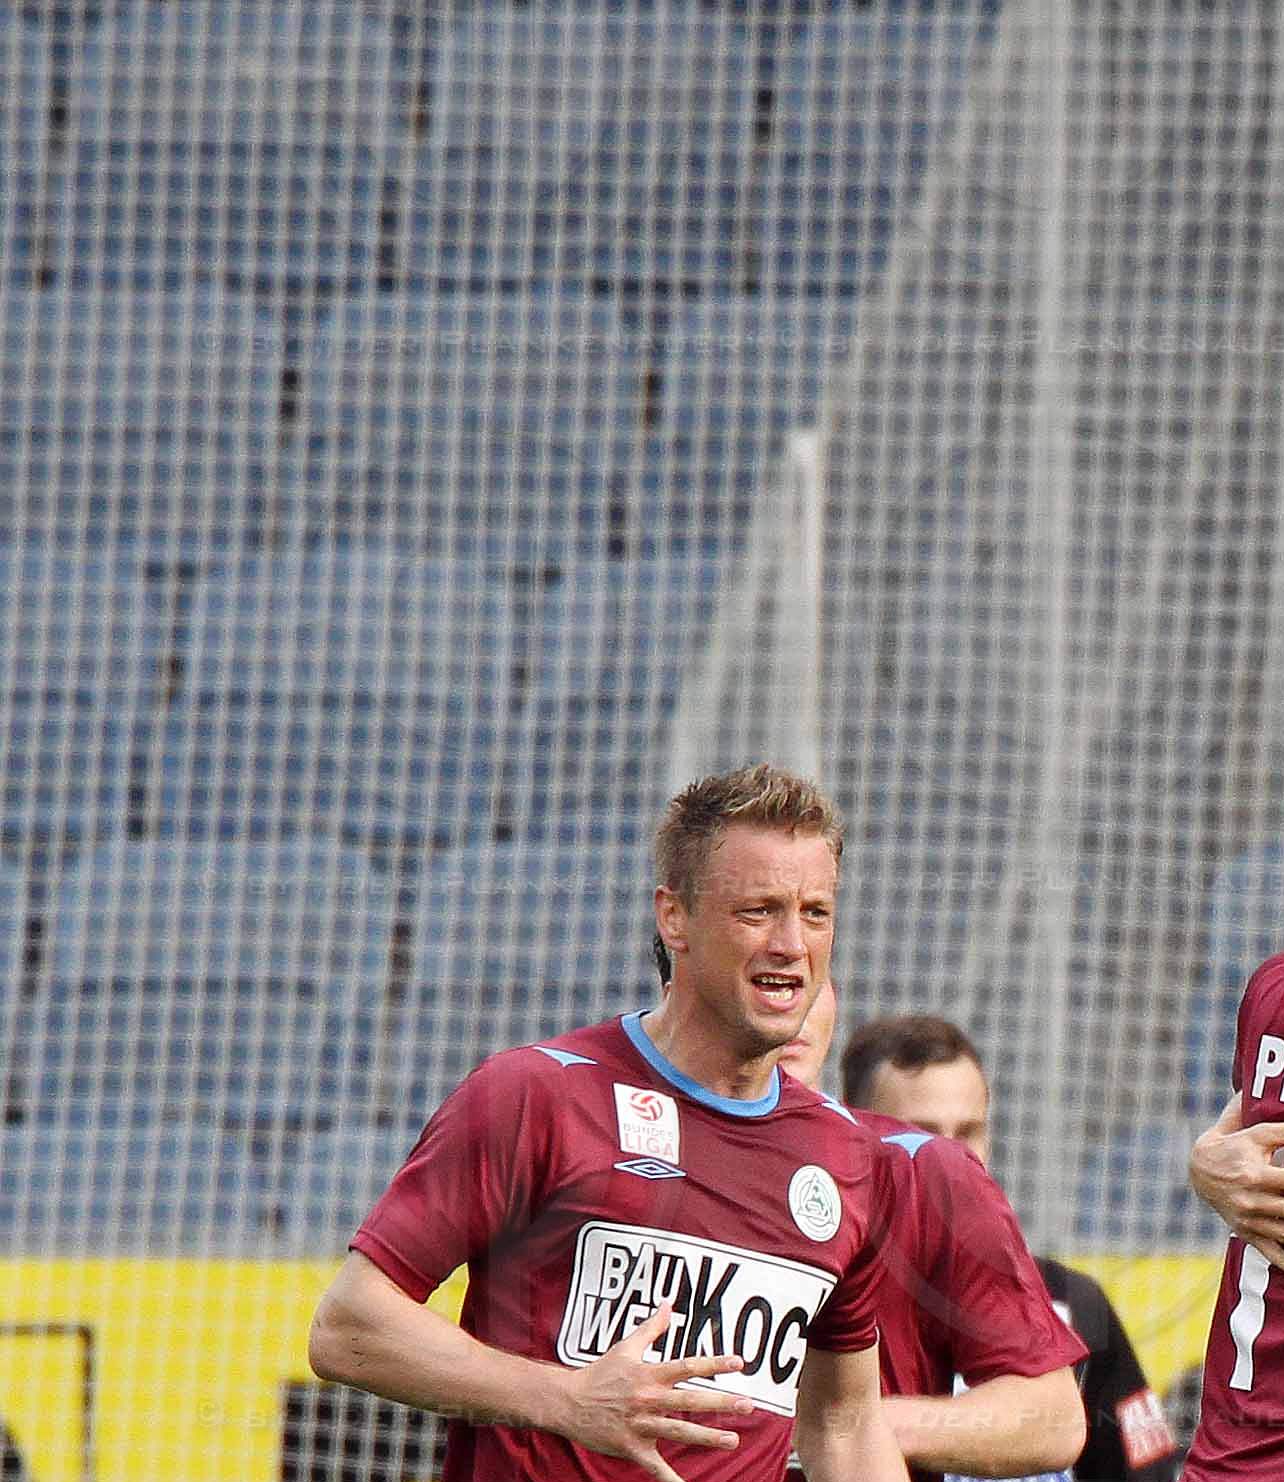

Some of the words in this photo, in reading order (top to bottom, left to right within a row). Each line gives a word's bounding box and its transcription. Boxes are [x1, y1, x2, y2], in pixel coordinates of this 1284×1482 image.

[623, 1132, 675, 1157] LIGA
[600, 1242, 688, 1307] BAU
[684, 1256, 826, 1386] KOC
